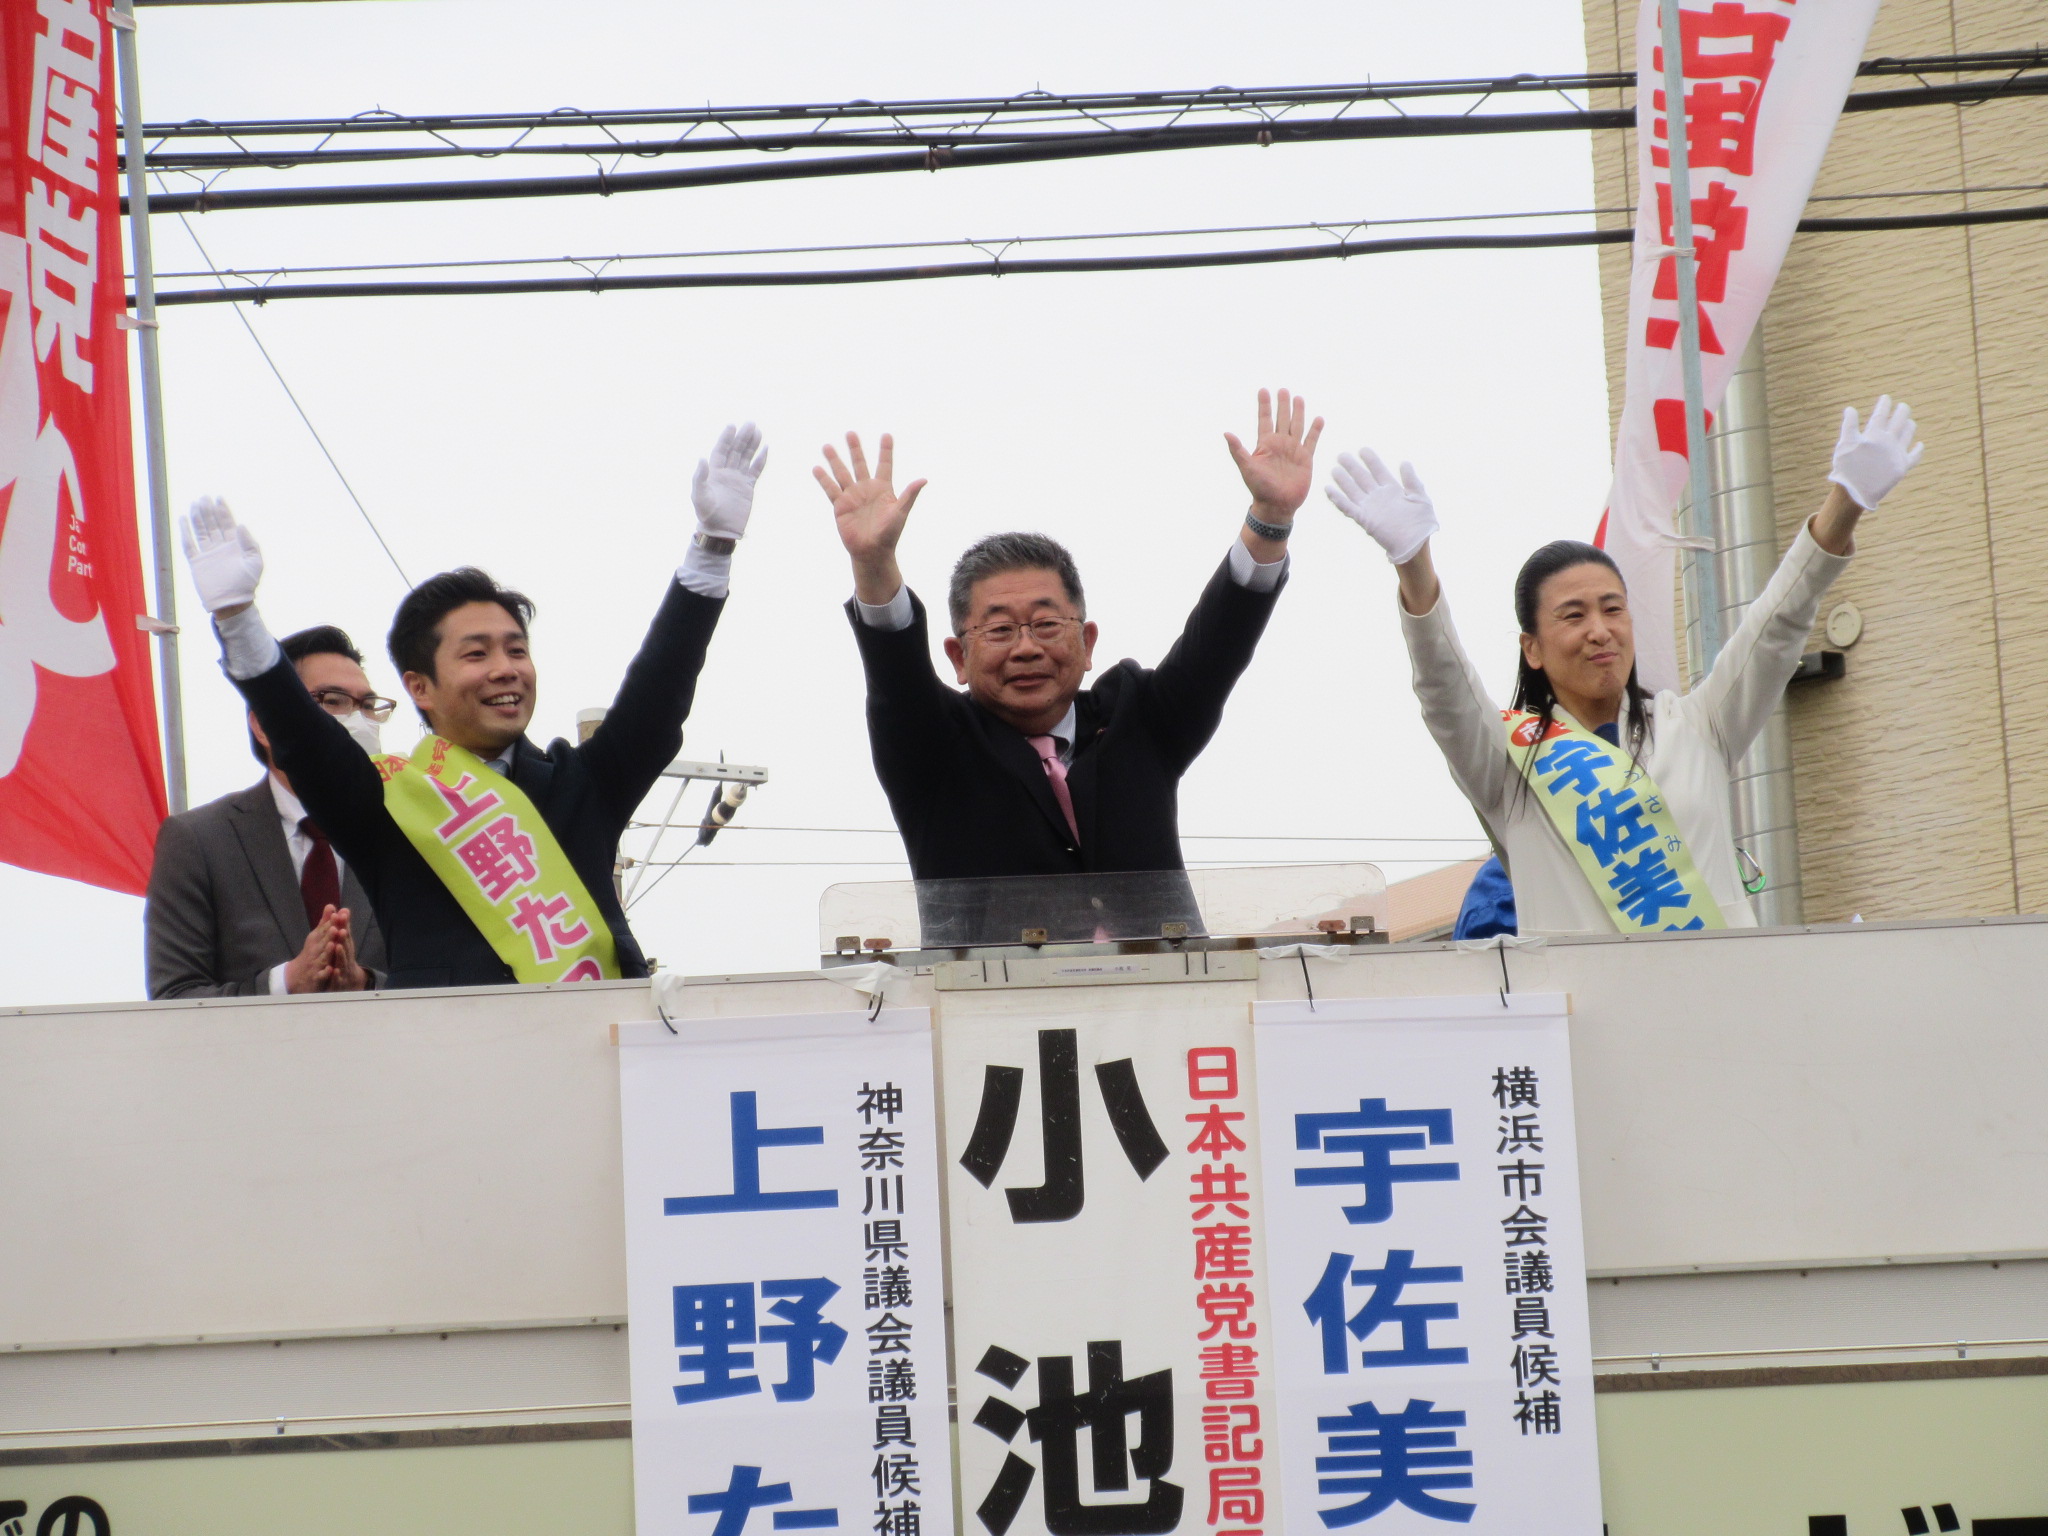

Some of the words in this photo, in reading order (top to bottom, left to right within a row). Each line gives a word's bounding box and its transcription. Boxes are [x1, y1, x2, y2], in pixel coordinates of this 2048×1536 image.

[1534, 739, 1705, 931] 宇佐美
[856, 1081, 922, 1536] 神奈川県議会議員候補
[1185, 1046, 1266, 1536] 日本共産党書記局
[1294, 1097, 1478, 1530] 宇佐美
[1491, 1065, 1562, 1437] 横浜市会議員候補
